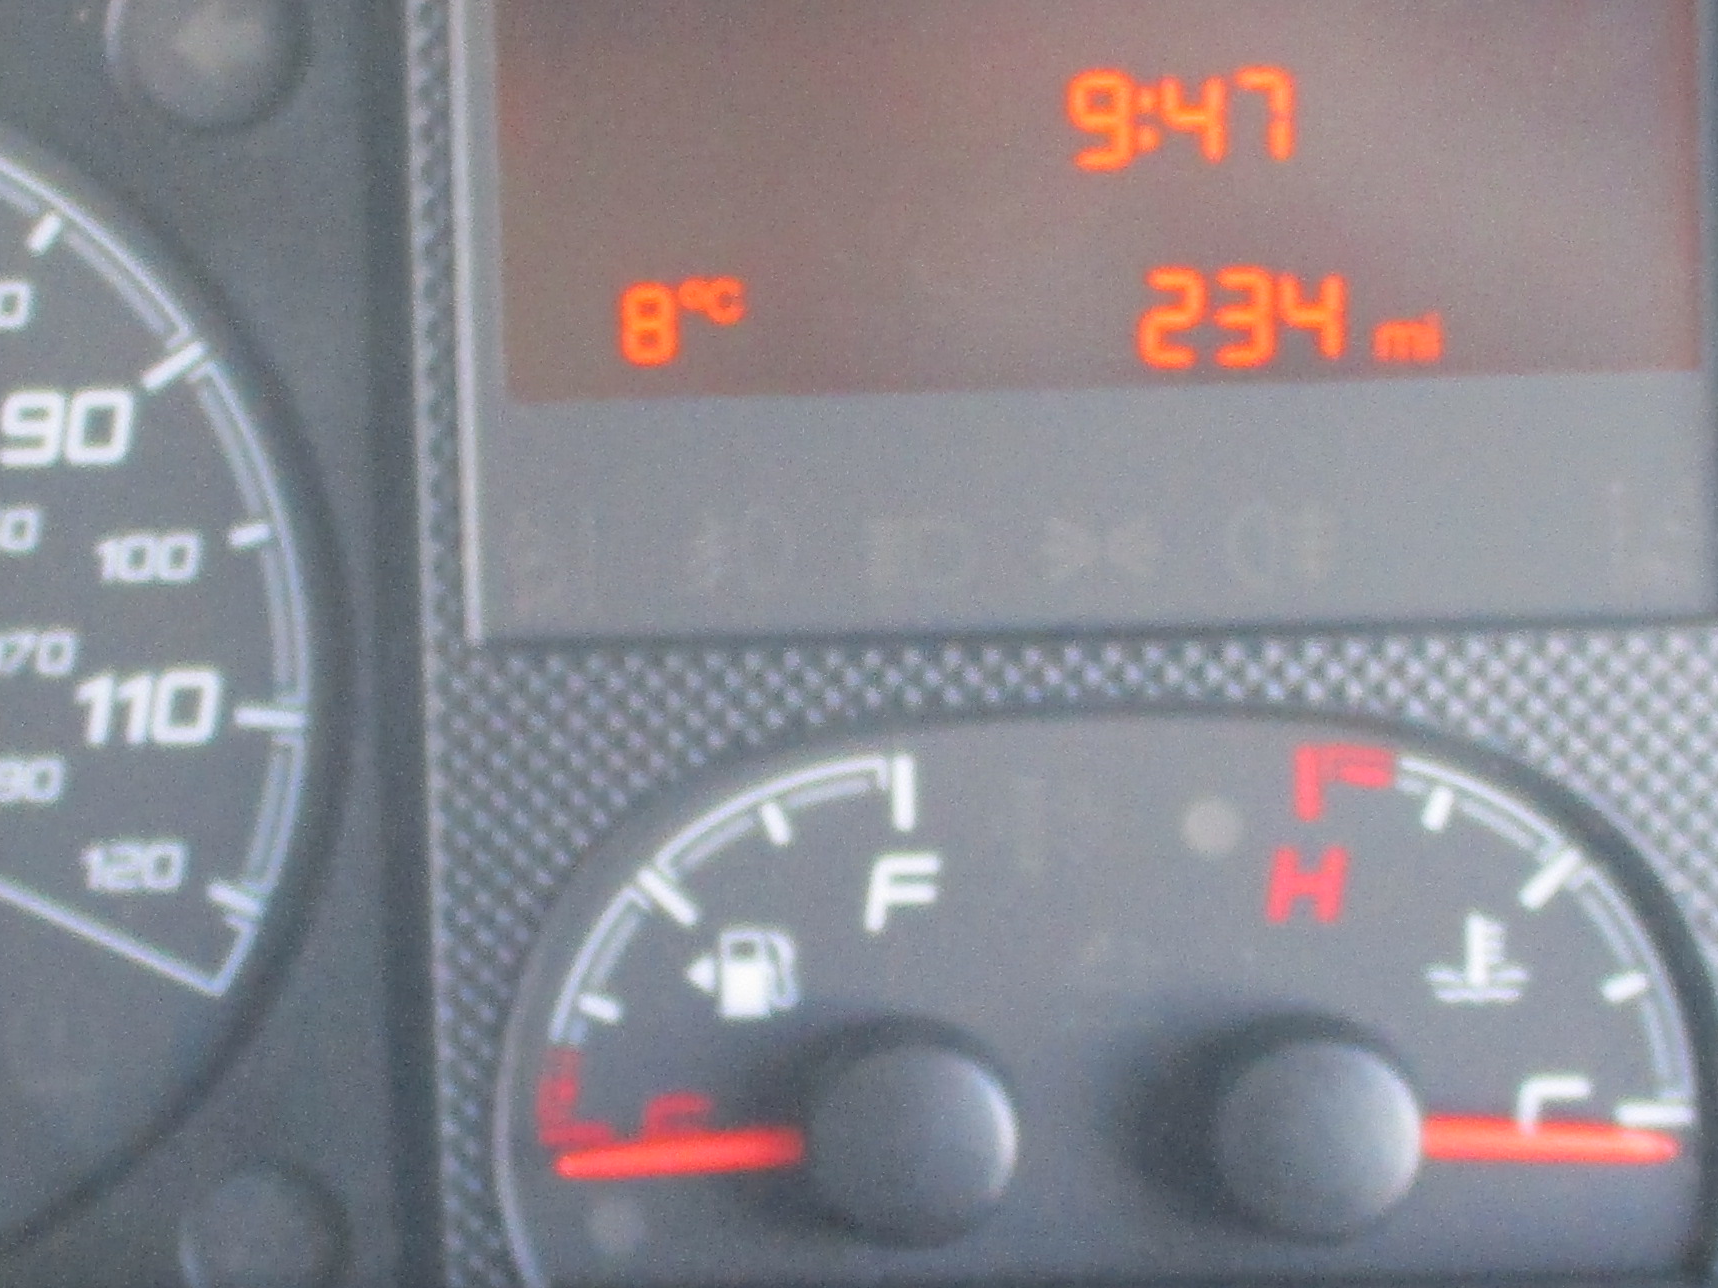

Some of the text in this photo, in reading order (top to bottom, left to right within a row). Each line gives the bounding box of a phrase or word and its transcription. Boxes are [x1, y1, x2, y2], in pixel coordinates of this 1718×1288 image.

[1068, 69, 1292, 167] 9:47
[1139, 269, 1440, 366] 234 mi
[0, 393, 130, 462] 90
[99, 535, 196, 581] 100
[79, 673, 218, 742] 110
[83, 846, 183, 890] 120
[869, 856, 939, 928] F
[1269, 850, 1344, 920] H
